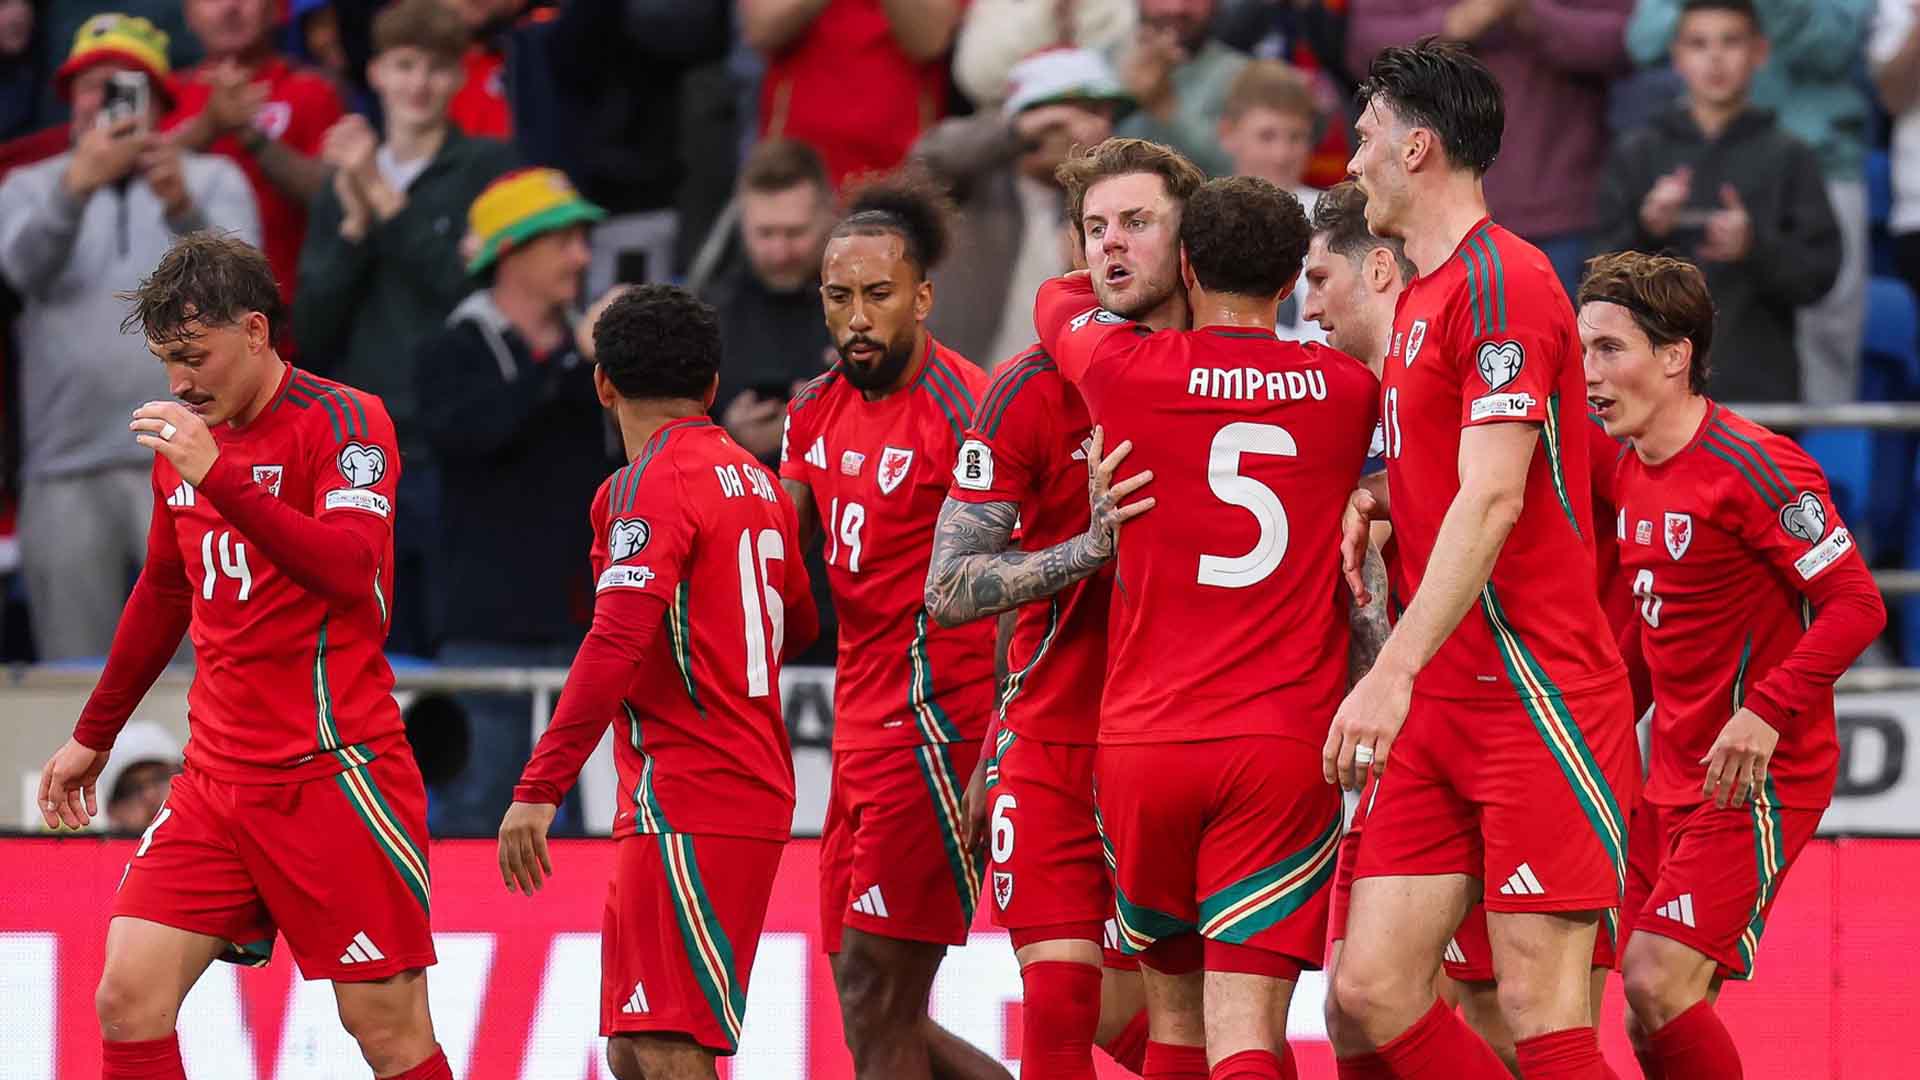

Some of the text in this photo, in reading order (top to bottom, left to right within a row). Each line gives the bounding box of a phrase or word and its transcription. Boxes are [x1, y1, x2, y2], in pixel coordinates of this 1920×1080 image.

[1188, 367, 1328, 401] AMPADU
[714, 464, 746, 498] DA
[1198, 421, 1298, 589] 5
[202, 531, 252, 601] 14
[829, 497, 865, 573] 19
[991, 794, 1017, 864] 6
